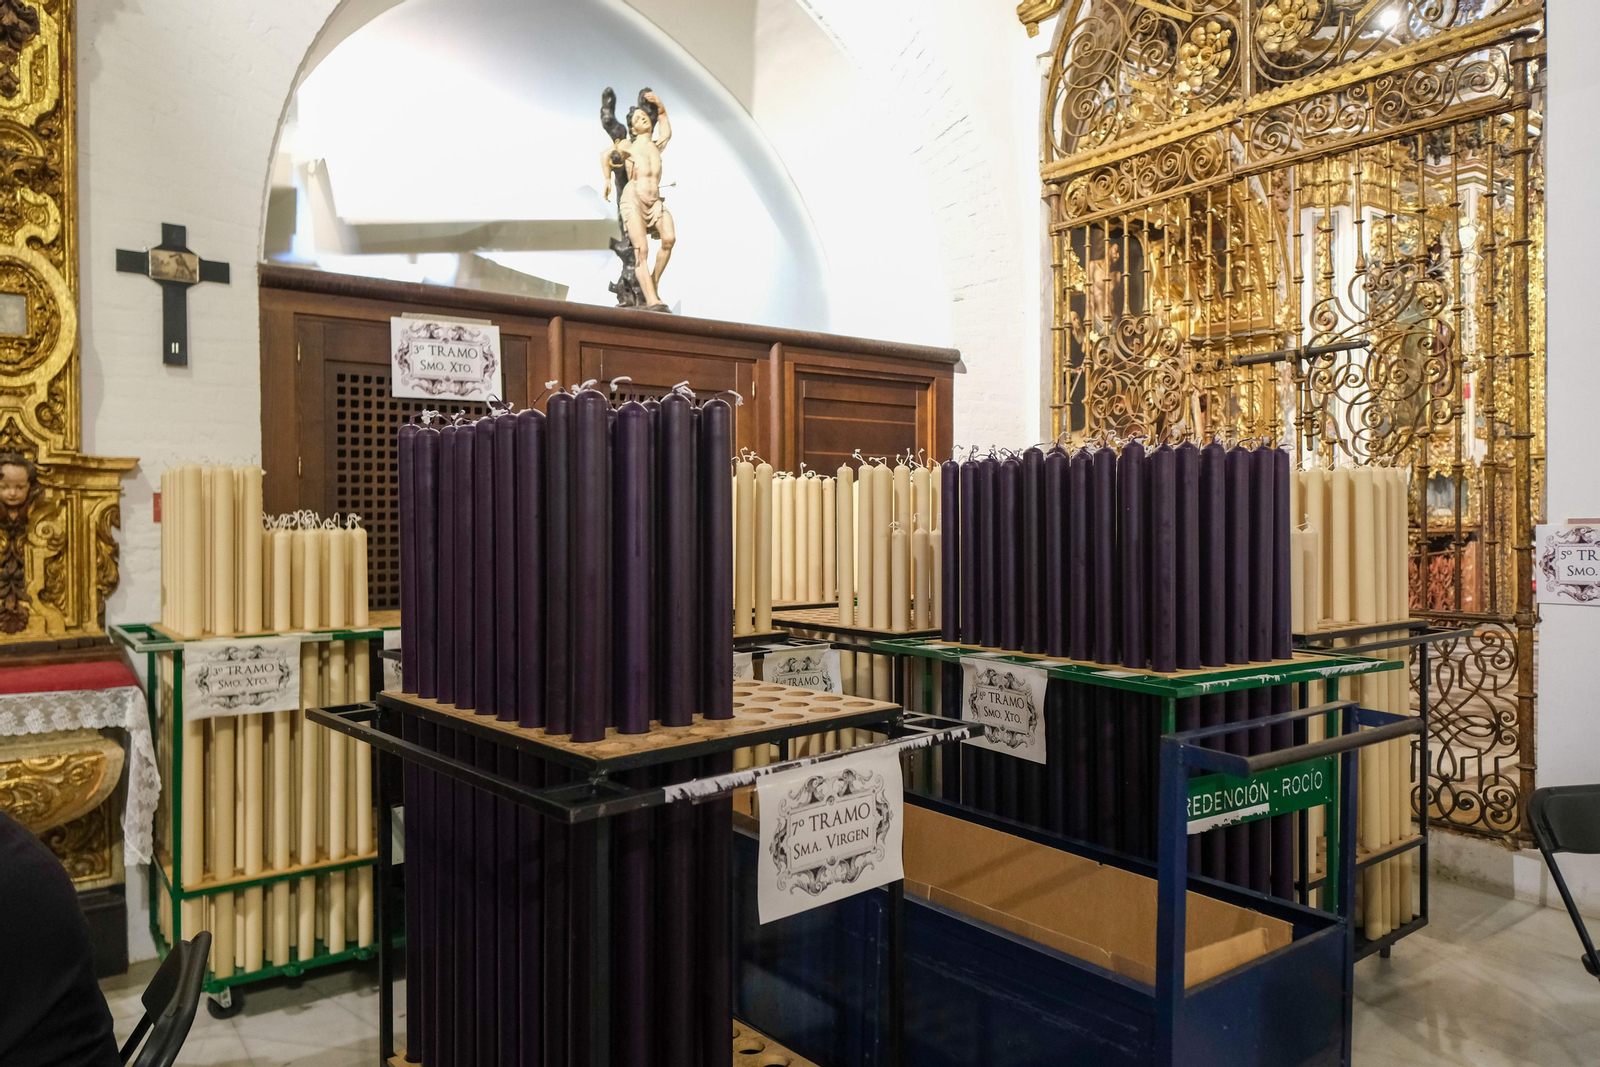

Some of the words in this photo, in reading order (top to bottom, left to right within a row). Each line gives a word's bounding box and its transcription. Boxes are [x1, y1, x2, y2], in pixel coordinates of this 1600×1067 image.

[413, 345, 425, 355] 3º
[428, 345, 478, 359] TRAMO
[420, 359, 446, 371] SMO.
[450, 361, 473, 373] XTO.
[1560, 550, 1573, 560] 5º
[1567, 565, 1598, 577] SMO.
[226, 663, 275, 676] TRAMO
[788, 675, 820, 687] TRAMO
[988, 691, 1025, 709] TRAMO
[983, 706, 1002, 720] SMO.
[1004, 710, 1022, 724] XTO.
[1282, 768, 1323, 797] ROCÍO
[792, 819, 805, 836] 7º
[809, 802, 871, 832] TRAMO
[793, 842, 822, 860] SMA.
[826, 827, 869, 849] VIRGEN
